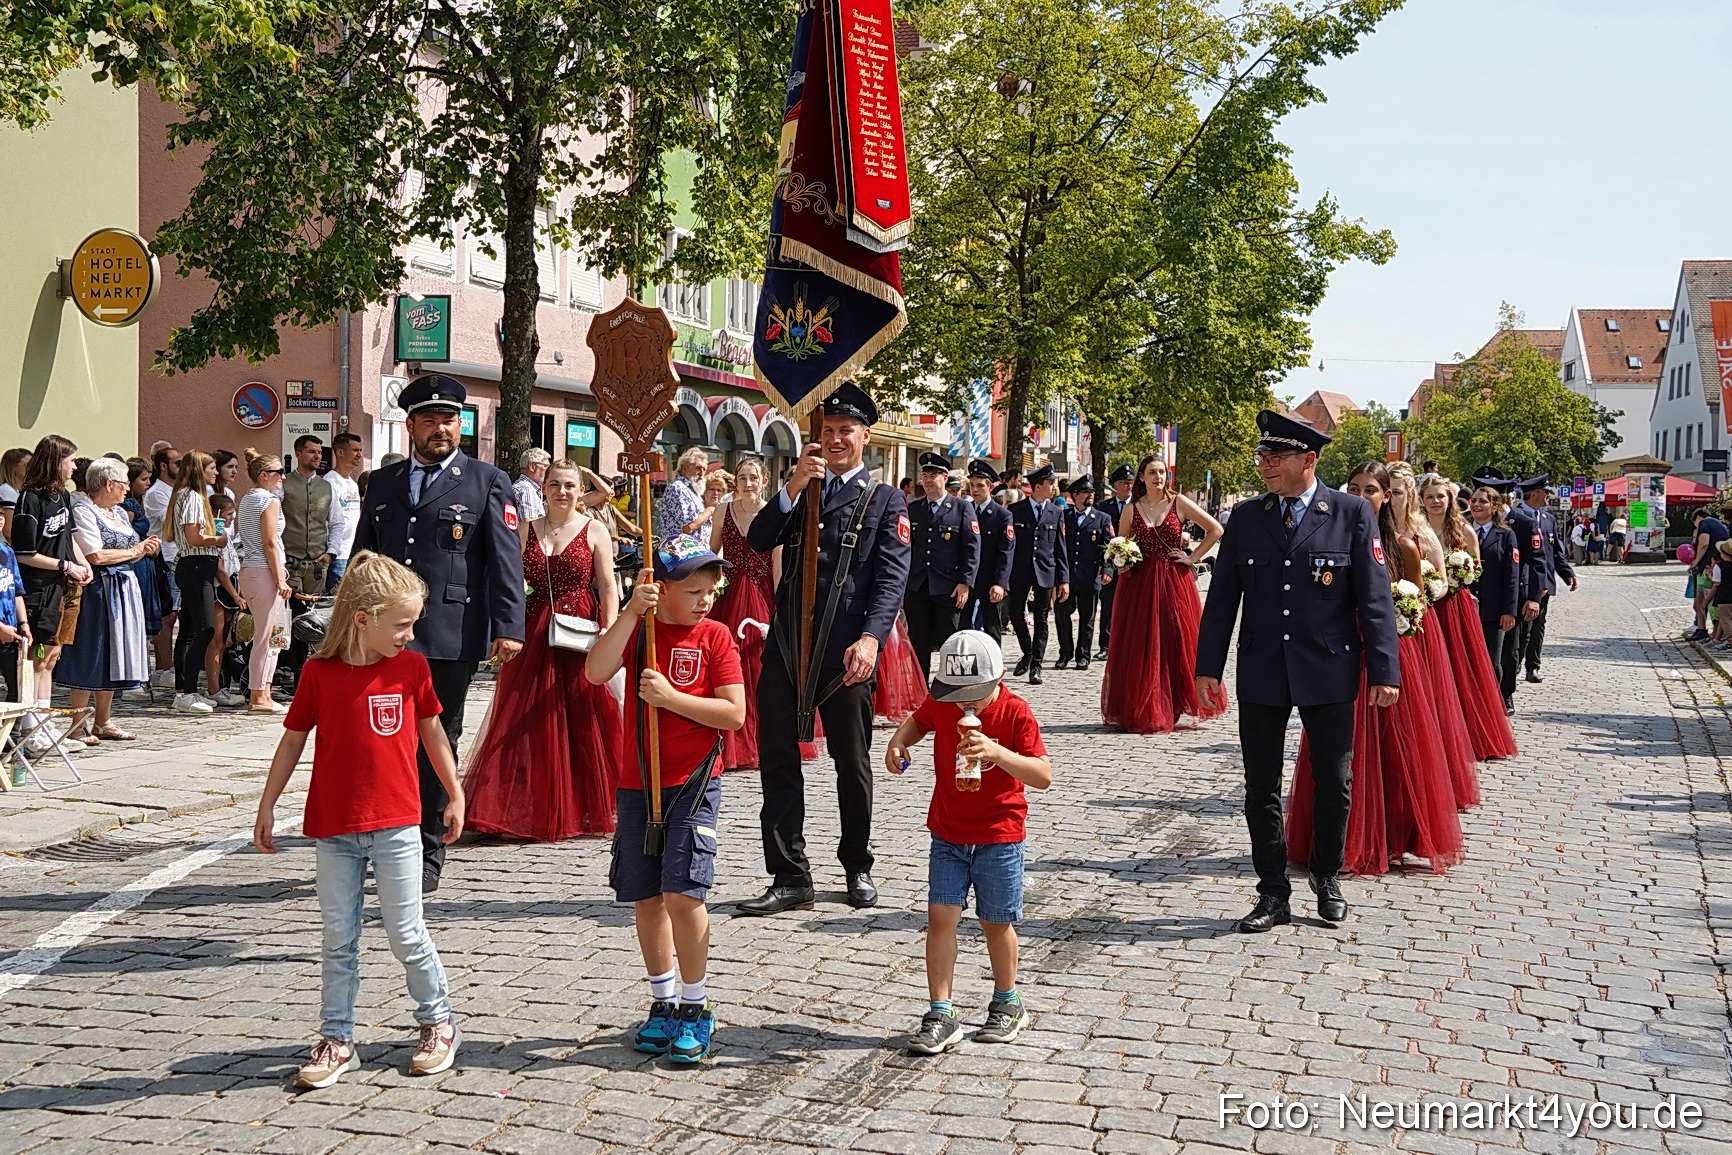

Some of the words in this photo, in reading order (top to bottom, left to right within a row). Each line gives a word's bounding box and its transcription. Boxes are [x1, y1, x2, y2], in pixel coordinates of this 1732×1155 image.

[90, 257, 143, 270] HOTEL
[90, 272, 122, 285] NEU
[90, 286, 142, 299] MARKT
[405, 307, 425, 320] vom
[412, 311, 441, 329] FASS
[287, 397, 337, 409] Bockwirtsgasse
[288, 426, 310, 435] Venezia
[603, 411, 634, 445] Freiwillige
[637, 408, 668, 444] Feuerwehr
[621, 455, 651, 473] Rasch
[946, 655, 976, 676] NY
